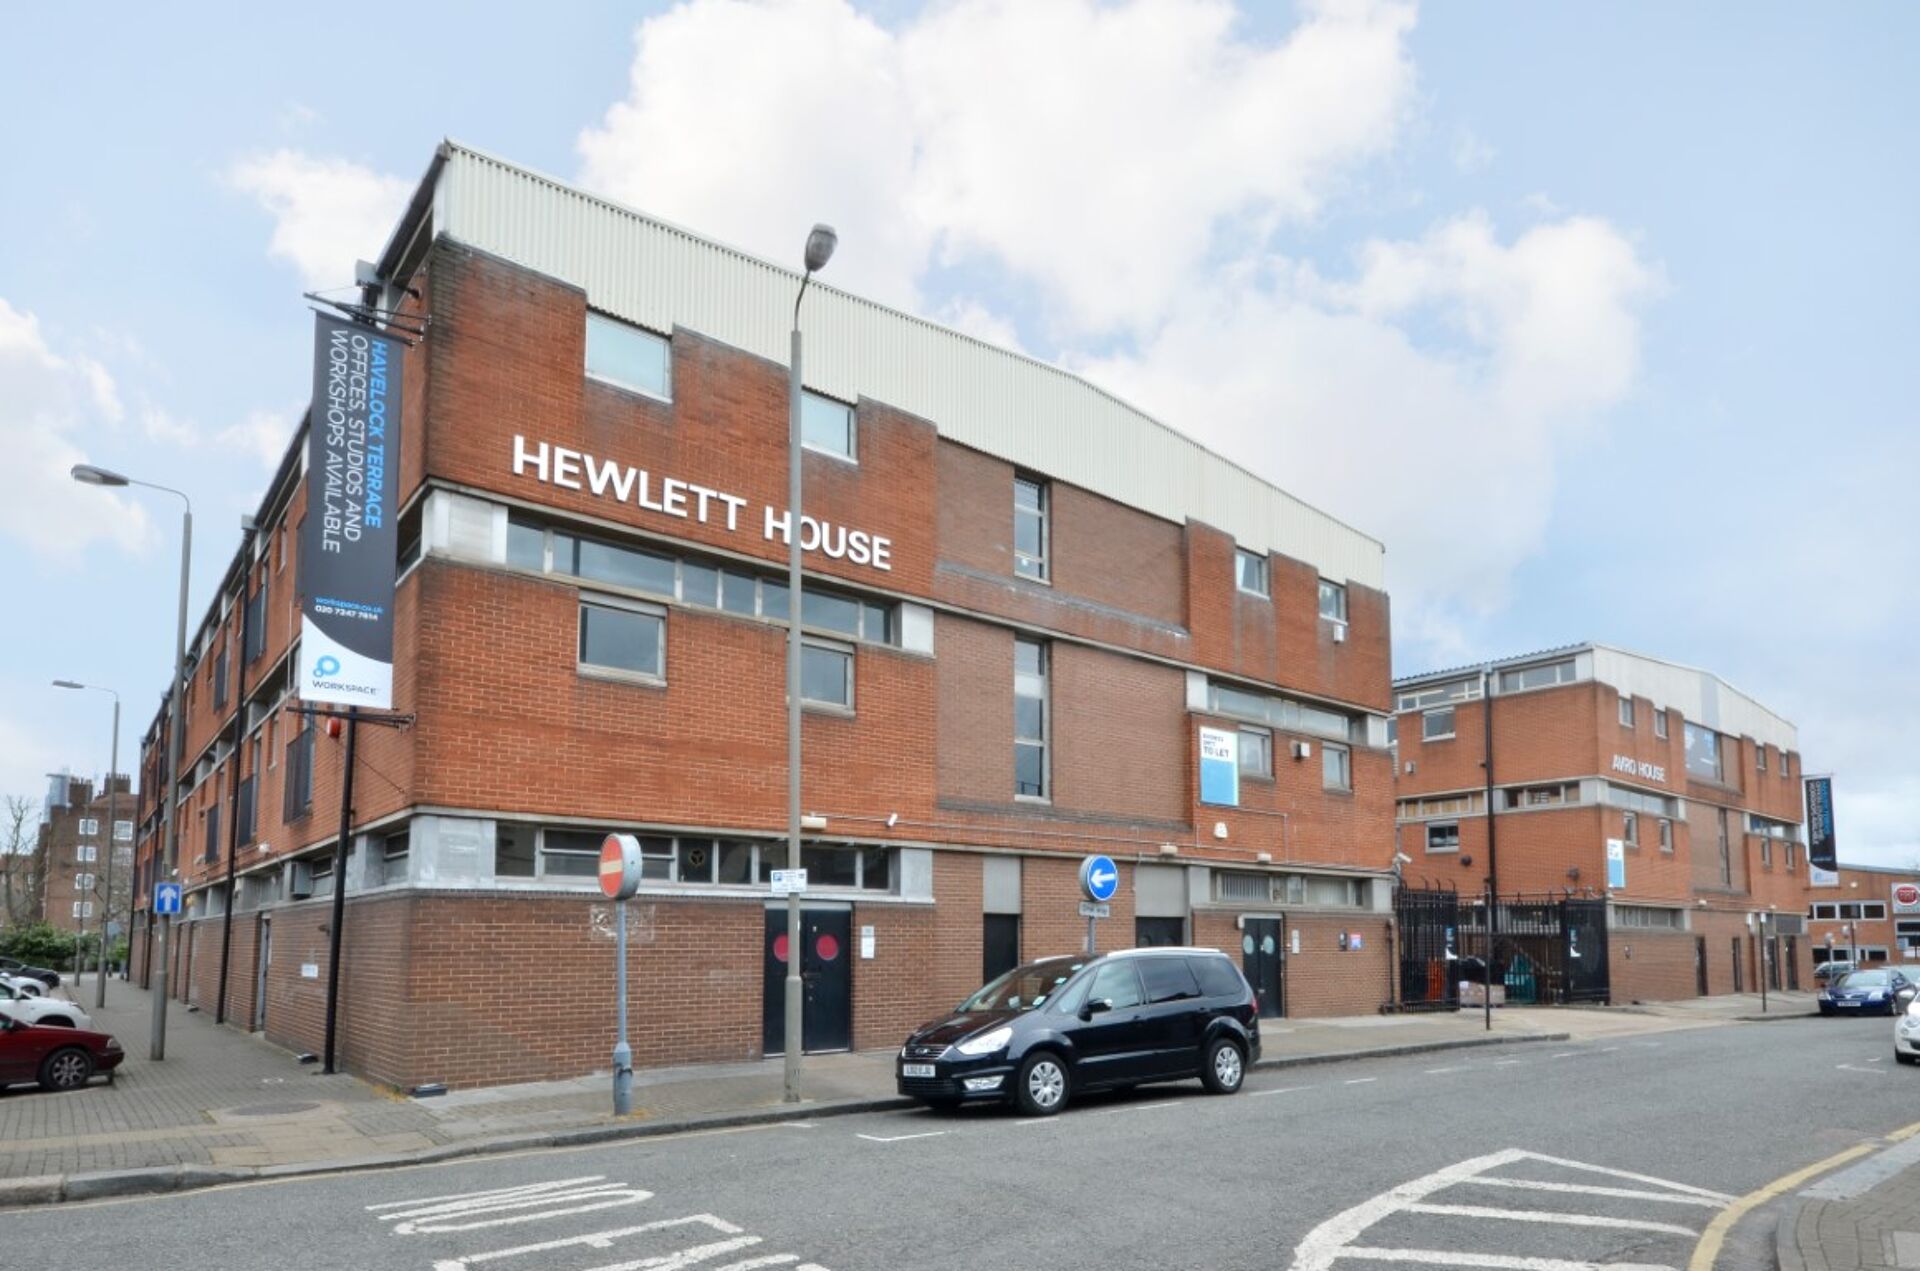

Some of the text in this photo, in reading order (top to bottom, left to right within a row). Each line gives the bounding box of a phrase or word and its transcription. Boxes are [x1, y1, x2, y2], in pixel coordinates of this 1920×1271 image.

[322, 329, 348, 553] WORKSHOPS AVAILABLE
[344, 335, 368, 542] OFFICES, STUDIOS AND
[365, 340, 387, 527] HAVELOCK TERRACE
[513, 434, 892, 571] HEWLETT HOUSE
[315, 604, 333, 614] 020
[312, 680, 377, 695] WORKSPACE
[1638, 760, 1665, 782] HOUSE
